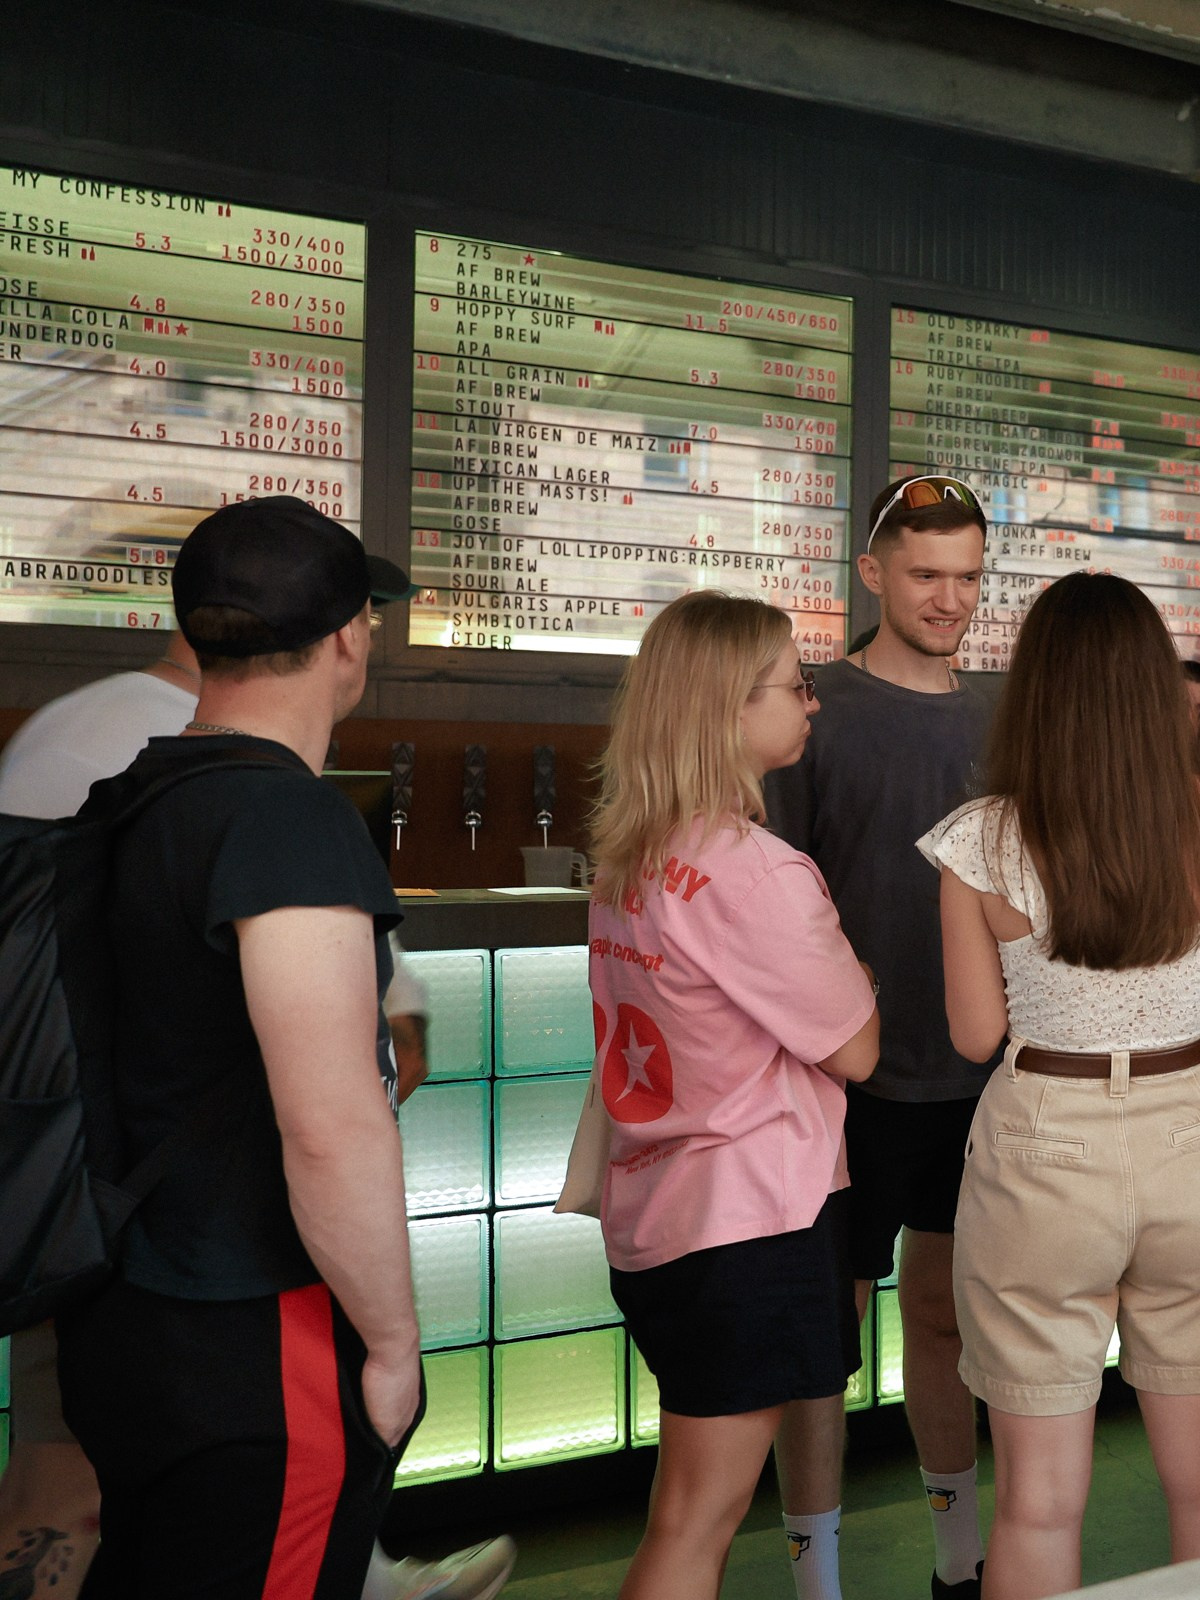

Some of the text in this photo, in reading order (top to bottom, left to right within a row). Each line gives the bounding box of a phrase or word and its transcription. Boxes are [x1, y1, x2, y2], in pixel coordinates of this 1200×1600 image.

[12, 169, 206, 215] MY CONFESSION
[135, 232, 172, 251] 5.3
[253, 228, 345, 256] 330/400
[430, 239, 439, 253] 8
[222, 244, 343, 275] 1500/3000
[457, 243, 492, 260] 275
[457, 262, 541, 287] AF BREW
[130, 294, 166, 313] 4.8
[251, 290, 345, 315] 280/350
[430, 298, 439, 312] 9
[457, 282, 576, 311] BARLEYWINE
[72, 308, 130, 331] COLA
[457, 301, 576, 329] HOPPY SURF
[686, 314, 727, 332] 11.5
[723, 301, 837, 332] 200/450/650
[292, 315, 344, 335] 1500
[456, 321, 541, 344] AF BREW
[928, 314, 1021, 339] OLD SPARKY
[457, 340, 491, 357] APA
[928, 332, 992, 351] AF BREW
[130, 358, 166, 376] 4.0
[251, 352, 344, 375] 330/400
[416, 355, 440, 371] 10
[928, 349, 1020, 373] TRIPLE IPA
[456, 360, 565, 385] ALL GRAIN
[691, 369, 718, 385] 5.3
[763, 361, 836, 384] 280/350
[927, 366, 964, 382] RUBY
[292, 377, 344, 396] 1500
[456, 378, 541, 401] AF BREW
[795, 384, 836, 401] 1500
[927, 383, 993, 401] AF BREW
[456, 399, 516, 418] STOUT
[926, 400, 1028, 422] CHERRY BEER
[130, 421, 167, 439] 4.5
[250, 413, 342, 437] 280/350
[416, 413, 439, 430] 11
[764, 414, 836, 436] 330/400
[926, 416, 992, 434] PERFECT
[454, 418, 656, 452] LA VIRGEN DE MAIZ
[691, 424, 718, 440] 7.0
[220, 431, 343, 457] 1500/3000
[455, 437, 538, 459] AF BREW
[794, 436, 834, 453] 1500
[926, 435, 943, 448] AF
[954, 436, 991, 451] BREW
[454, 456, 610, 485] MEXICAN LAGER
[926, 450, 1046, 475] DOUBLE NE IPA
[249, 475, 343, 497] 280/350
[691, 480, 718, 494] 4.5
[762, 468, 834, 488] 280/350
[983, 473, 1028, 489] MAGIC
[127, 487, 163, 502] 4.5
[454, 477, 607, 502] UP THE MASTS!
[793, 490, 833, 506] 1500
[454, 496, 538, 516] AF BREW
[454, 515, 501, 532] GOSE
[762, 522, 833, 541] 280/350
[994, 525, 1036, 540] TONKA
[416, 531, 440, 547] 13
[453, 534, 488, 551] JOY
[504, 538, 524, 553] OF
[689, 534, 715, 548] 4.8
[130, 548, 166, 565] 5.8
[793, 542, 832, 558] 1500
[1020, 544, 1046, 557] FFF
[1056, 547, 1091, 561] BREW
[453, 554, 537, 573] AF BREW
[5, 561, 168, 586] ABRADOODLES
[453, 573, 549, 592] SOUR ALE
[1001, 577, 1035, 589] PIMP
[760, 575, 832, 593] 330/400
[453, 592, 621, 616] VULGARIS APPLE
[793, 596, 832, 611] 1500
[127, 612, 161, 628] 6.7
[453, 612, 574, 632] SYMBIOTICA
[452, 631, 512, 650] CIDER
